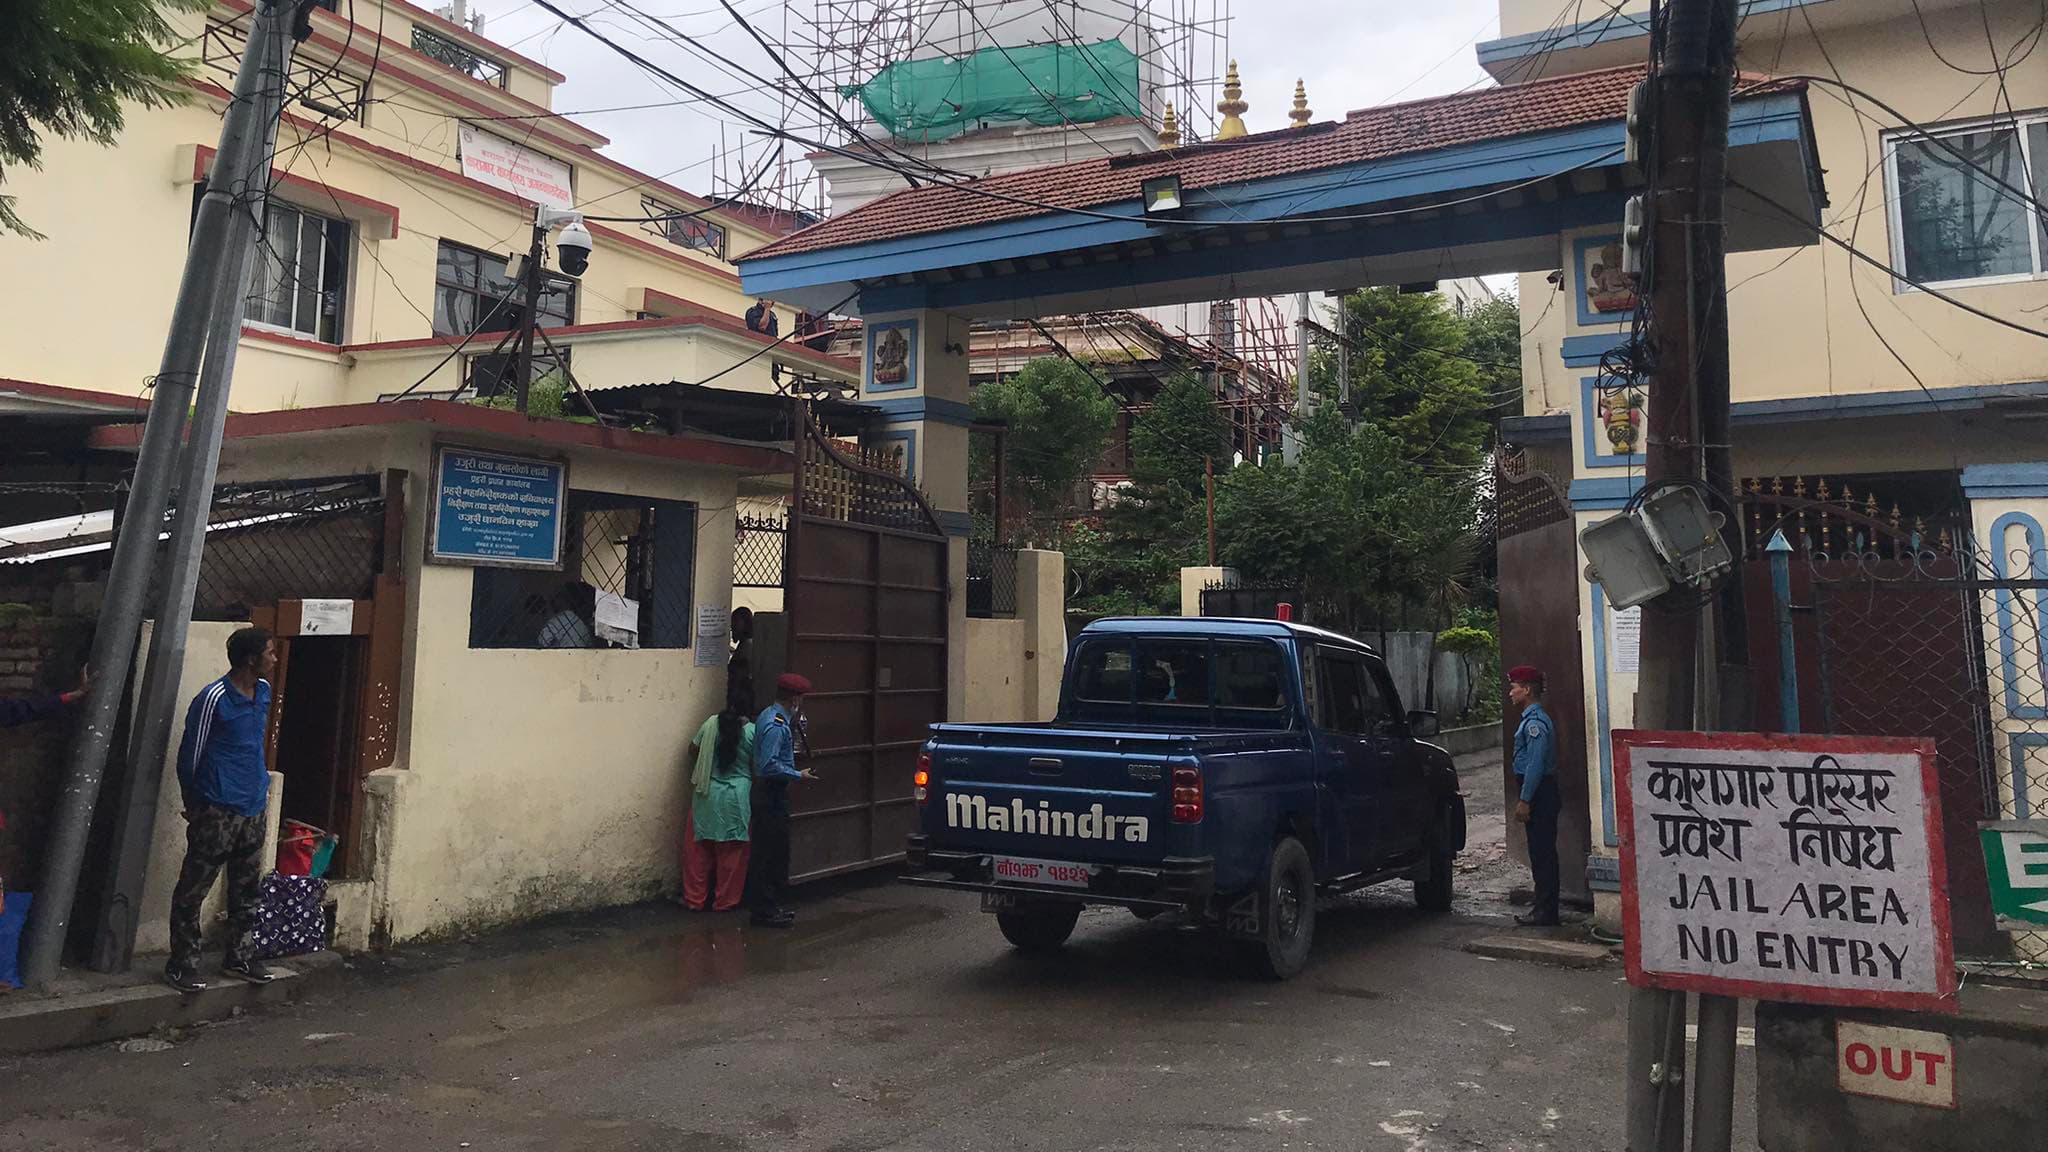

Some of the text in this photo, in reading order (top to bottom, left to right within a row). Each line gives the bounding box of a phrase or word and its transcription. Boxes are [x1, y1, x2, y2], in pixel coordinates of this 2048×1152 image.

[1647, 754, 1896, 815] कारागार परिसर
[945, 793, 1149, 843] Mahindra
[1650, 803, 1902, 873] प्रवेश निषेध
[1669, 873, 1910, 925] JAIL AREA
[1678, 924, 1909, 980] NO ENTRY
[1845, 1042, 1946, 1086] OUT
